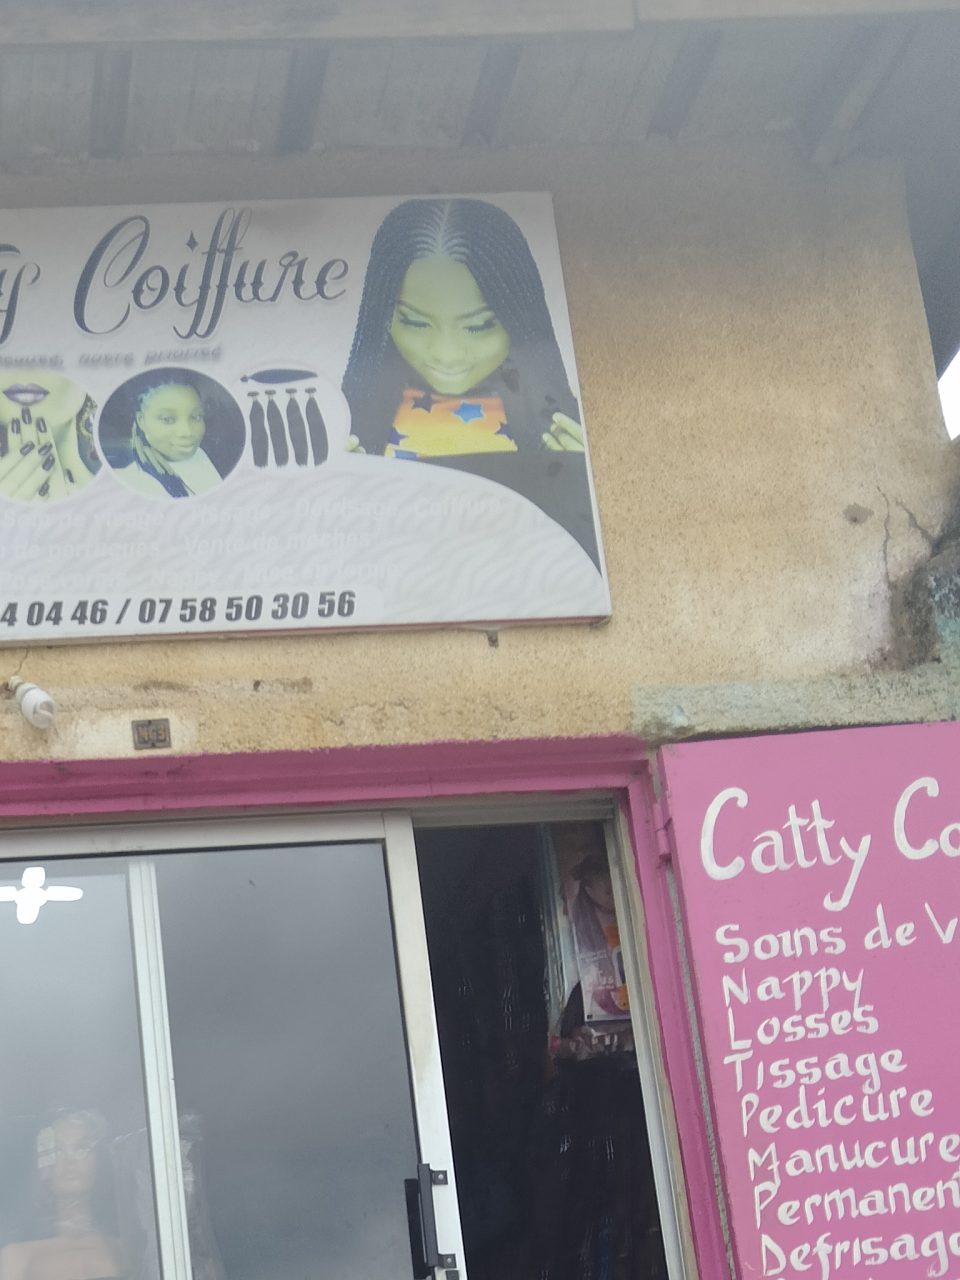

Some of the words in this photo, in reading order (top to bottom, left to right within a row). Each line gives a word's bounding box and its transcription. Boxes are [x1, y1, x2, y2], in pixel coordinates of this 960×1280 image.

[74, 208, 349, 339] Coiffure
[26, 601, 63, 627] 04
[71, 599, 108, 625] 46
[116, 598, 131, 625] /
[139, 597, 172, 624] 07
[180, 596, 216, 623] 58
[226, 595, 263, 622] 50
[271, 592, 309, 620] 30
[318, 590, 356, 618] 56
[700, 787, 872, 911] Catty
[864, 903, 917, 951] de
[722, 967, 864, 1013] Nappy
[728, 1004, 879, 1051] Losses
[723, 1047, 908, 1094] Tissage
[741, 1085, 935, 1137] Pedicure
[746, 1132, 960, 1187] Manucure
[753, 1169, 960, 1230] Permanen
